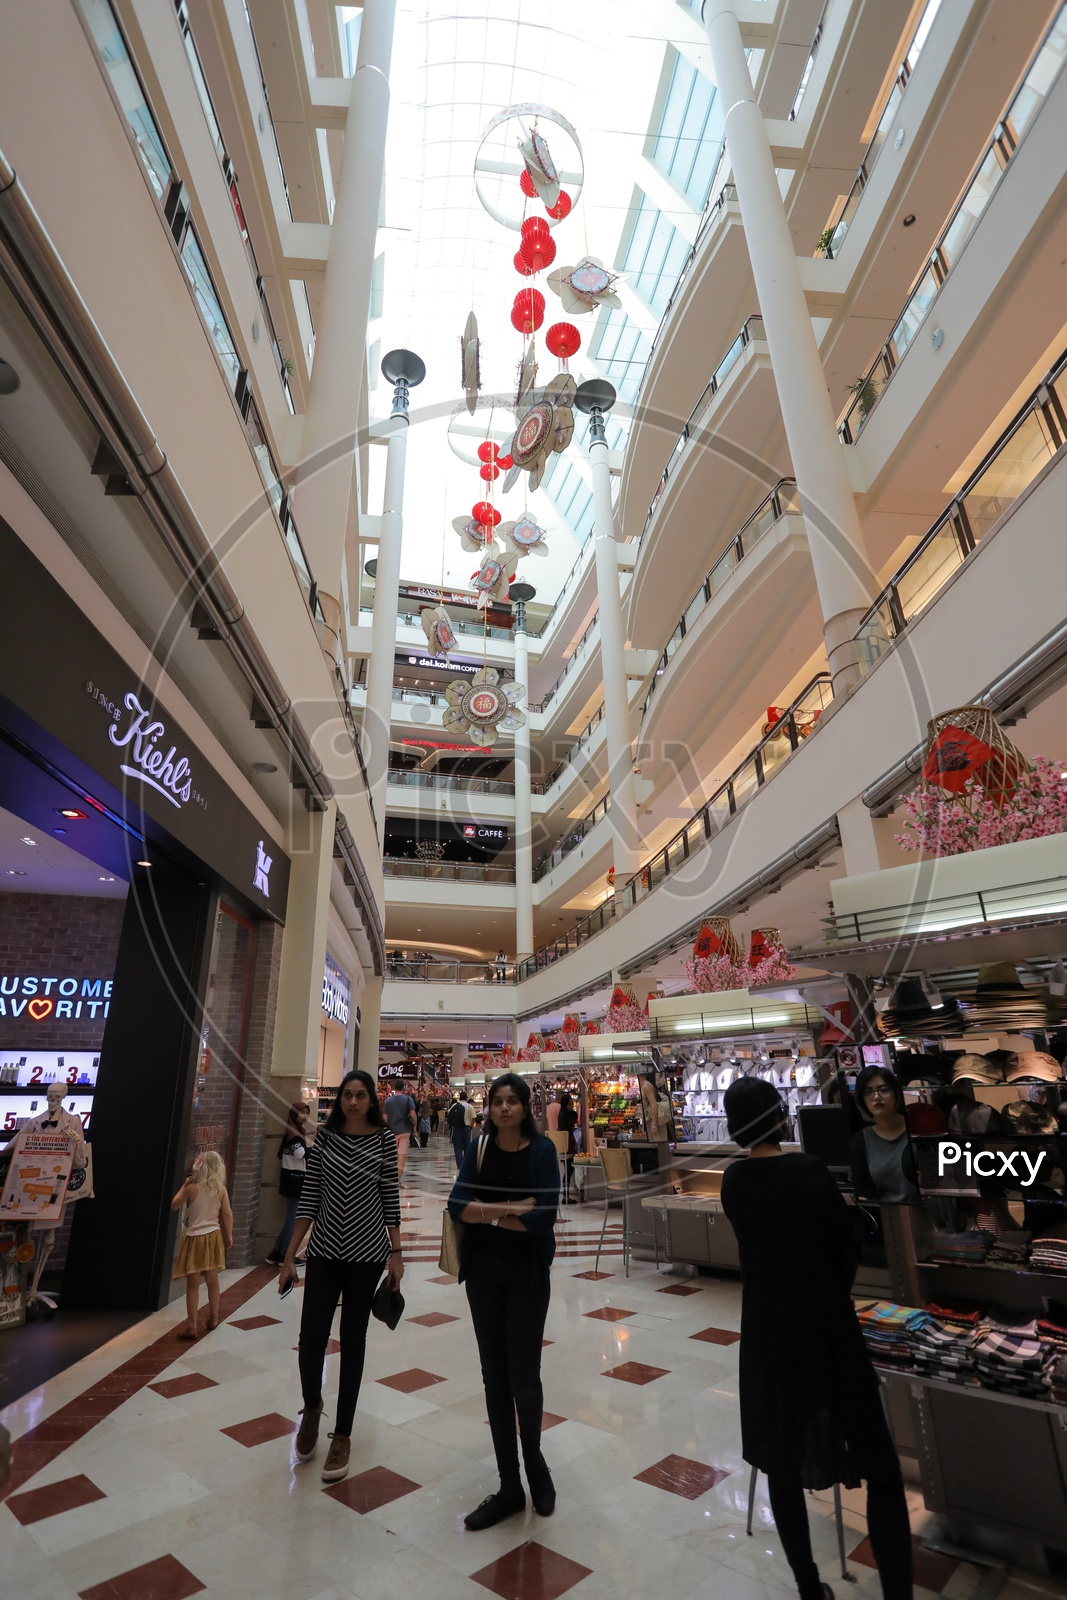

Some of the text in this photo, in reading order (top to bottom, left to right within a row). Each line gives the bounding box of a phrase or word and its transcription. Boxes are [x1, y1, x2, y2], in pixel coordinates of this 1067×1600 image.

[85, 681, 122, 721] SINCE
[476, 697, 492, 710] 福
[108, 692, 192, 803] Kiehl's
[402, 738, 493, 755] SAN FRANCISCO COFFEE
[751, 944, 764, 957] 旺
[30, 1066, 44, 1084] 2
[66, 1066, 79, 1085] 3
[3, 1112, 17, 1131] 5
